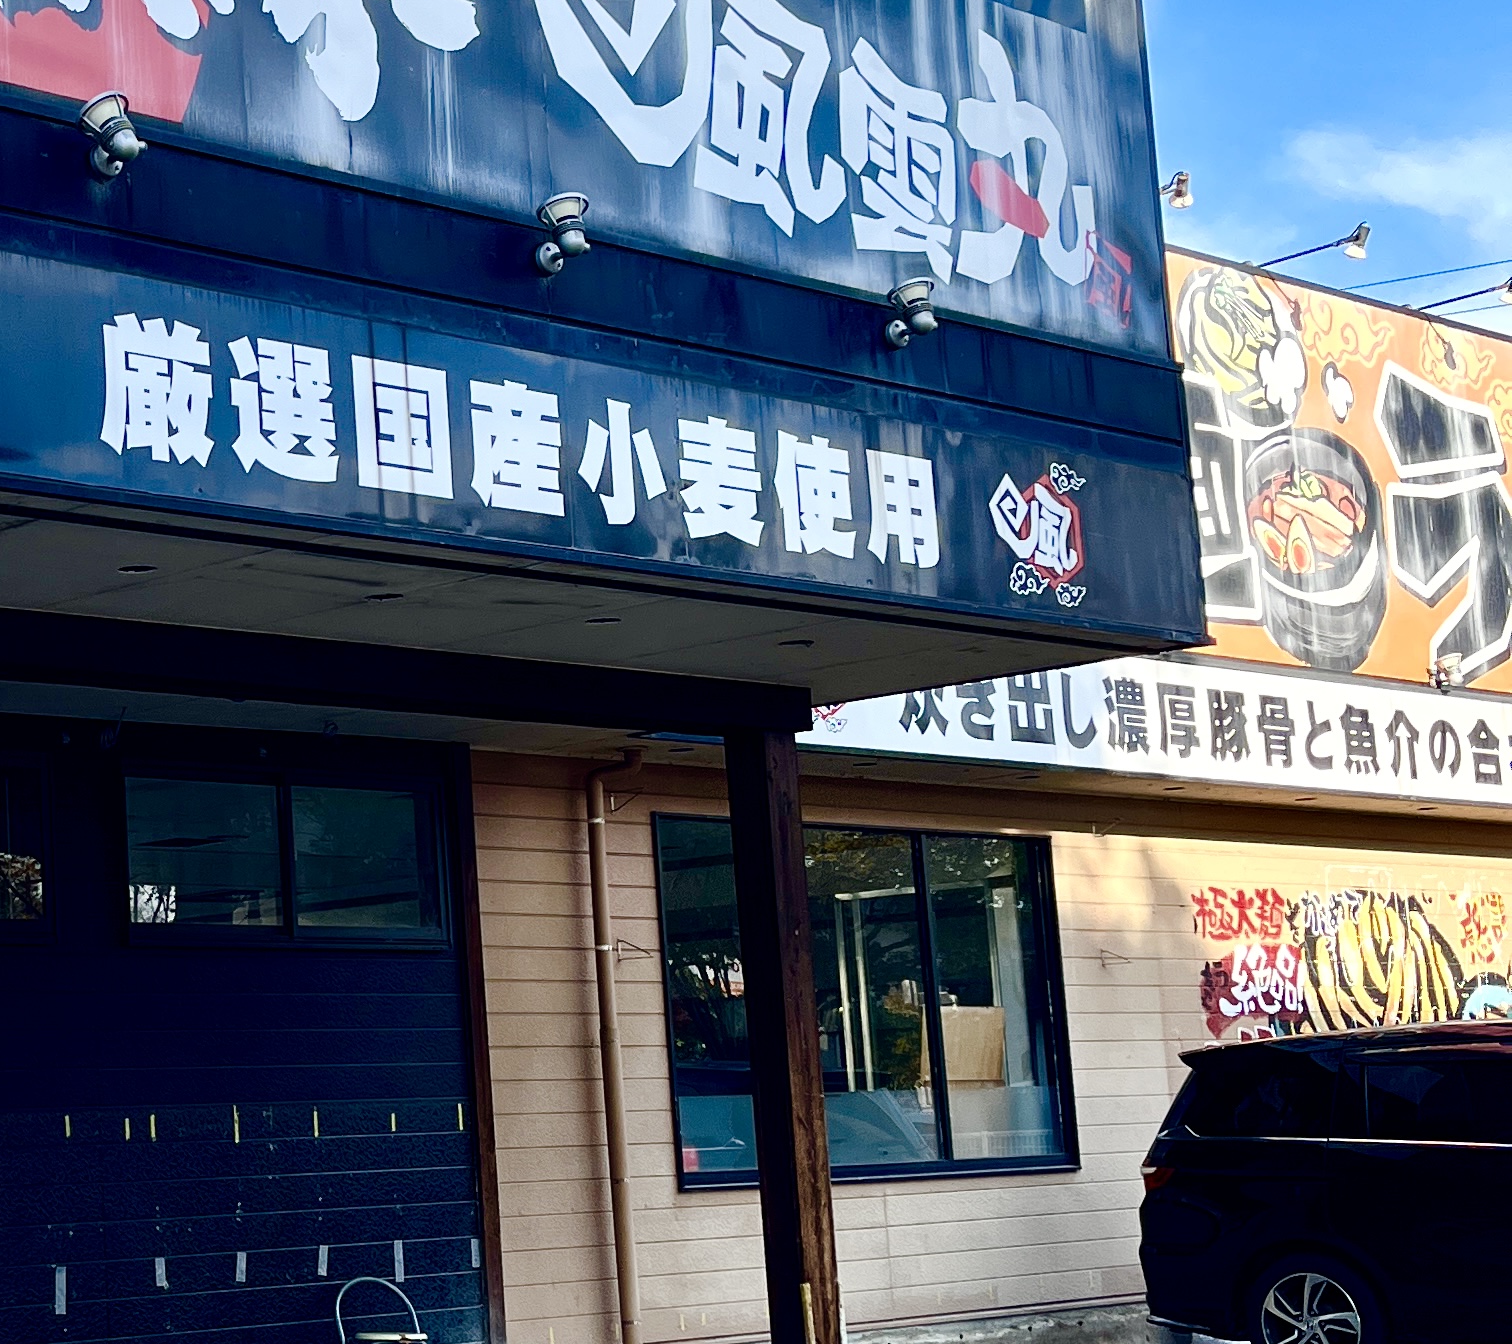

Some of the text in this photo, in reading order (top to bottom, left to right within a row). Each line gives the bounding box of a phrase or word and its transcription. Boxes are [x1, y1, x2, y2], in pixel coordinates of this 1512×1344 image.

[100, 313, 940, 568] 厳選国産小麦使用
[899, 670, 1512, 786] 炊き出し濃厚豚骨と魚介の合
